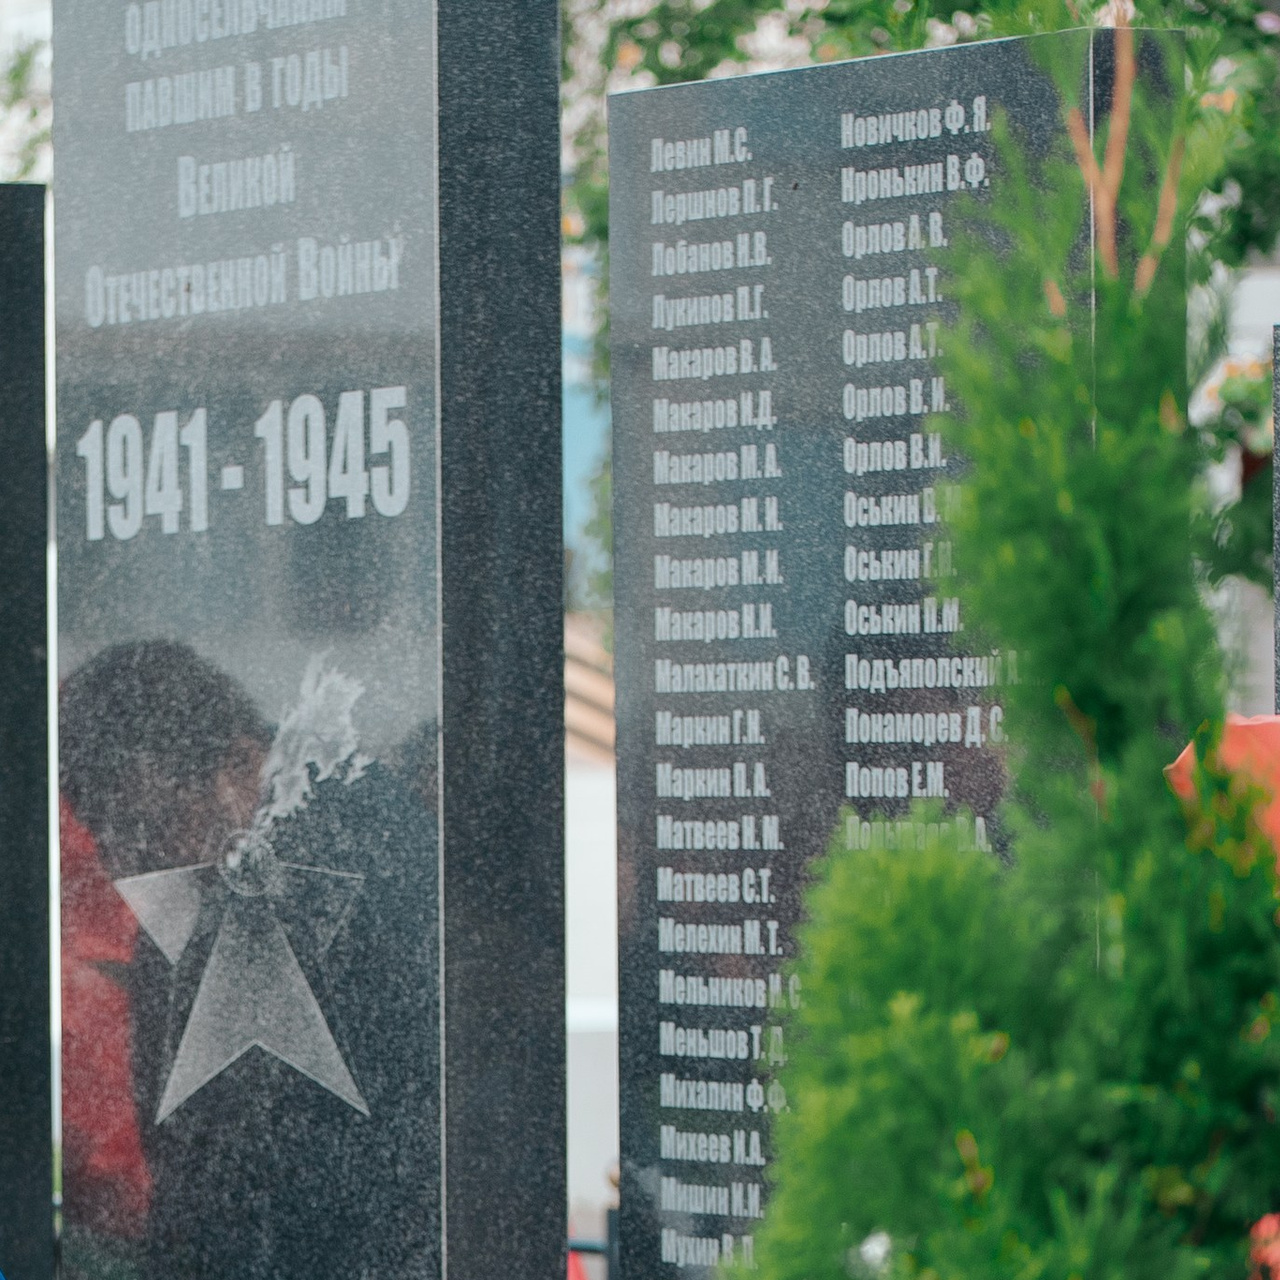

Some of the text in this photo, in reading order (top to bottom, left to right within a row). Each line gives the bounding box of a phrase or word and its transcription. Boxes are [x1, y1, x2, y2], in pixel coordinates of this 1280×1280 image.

[126, 45, 349, 132] ПАВШИМ В ГОДЫ
[841, 108, 942, 149] Новичков
[651, 127, 753, 173] Левин М.С.
[652, 239, 735, 276] Лобанов
[842, 221, 905, 259] Орлов
[652, 294, 735, 331] Лукинов
[842, 274, 905, 313] Орлов
[653, 346, 738, 380] Макаров
[843, 329, 906, 367] Орлов
[653, 398, 738, 433] Макаров
[843, 383, 906, 422] Орлов
[76, 408, 209, 542] 1941
[254, 386, 412, 526] 1945
[654, 451, 738, 485] Макаров
[843, 437, 907, 476] Орлов
[654, 503, 739, 538] Макаров
[844, 492, 919, 528] Оськин
[654, 555, 739, 590] Макаров
[844, 545, 920, 582] Оськин
[655, 607, 740, 643] Макаров
[844, 599, 920, 636] Оськин
[655, 659, 774, 693] Малахаткин
[845, 649, 1002, 693] Подъяполский
[656, 710, 730, 748] Маркин
[845, 708, 961, 746] Понаморев
[656, 763, 731, 801] Маркин
[846, 762, 908, 797] Попов
[657, 815, 739, 850] Матвеев
[657, 867, 740, 903] Матвеев
[658, 917, 742, 954] Мелехин
[659, 969, 766, 1008] Мельников
[659, 1021, 748, 1059] Меньшов
[660, 1073, 744, 1111] Михалин
[660, 1125, 731, 1164] Михеев
[661, 1228, 719, 1268] Мухин
